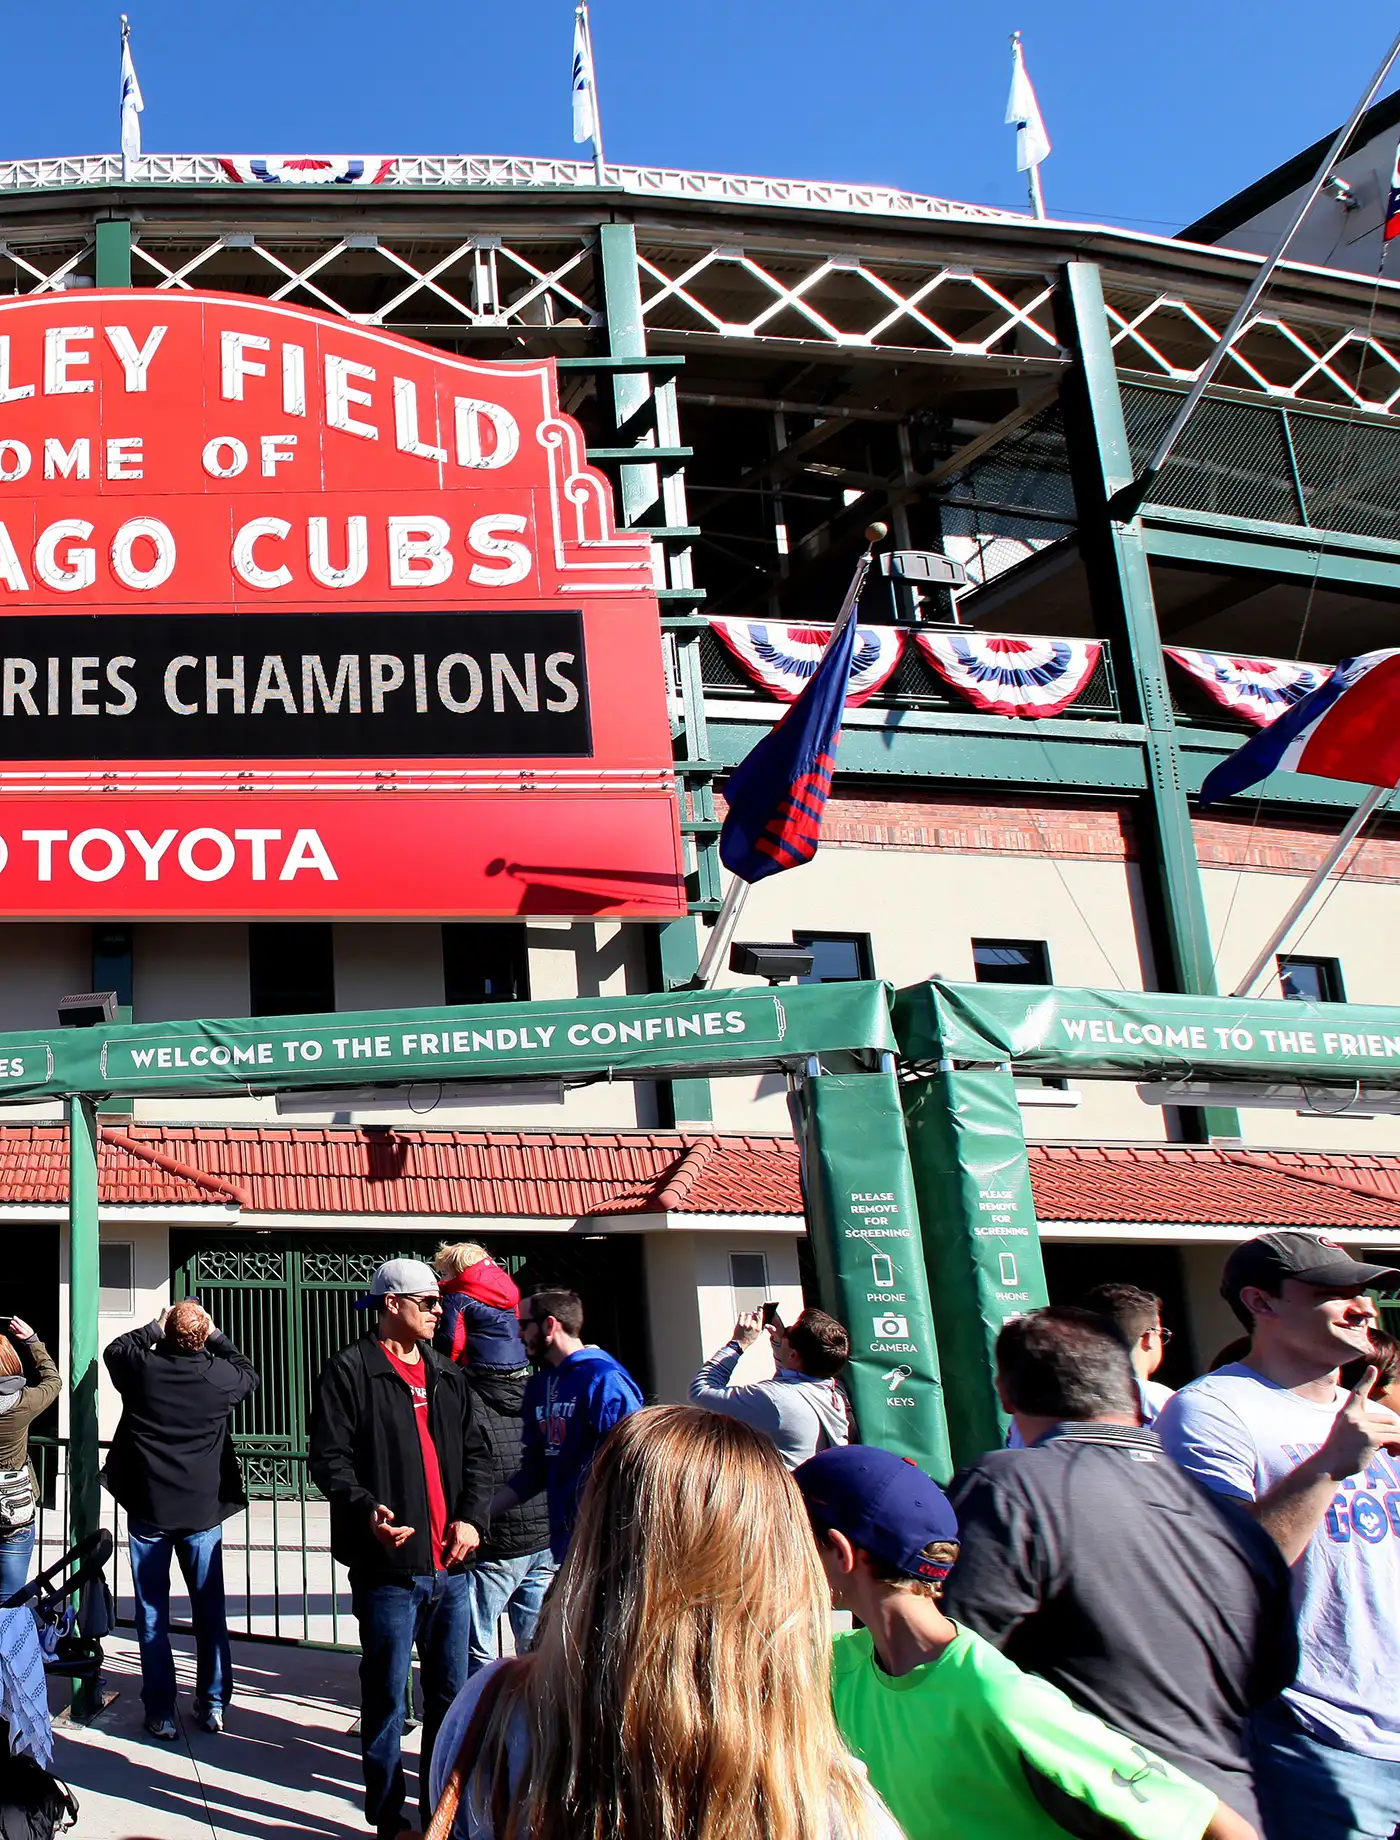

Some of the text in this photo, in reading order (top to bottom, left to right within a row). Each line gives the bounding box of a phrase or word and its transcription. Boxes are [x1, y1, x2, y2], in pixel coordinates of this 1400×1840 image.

[220, 330, 520, 470] FIELD
[201, 434, 298, 480] OF
[232, 513, 533, 590] CUBS
[163, 651, 580, 717] CHAMPIONS
[21, 826, 339, 882] TOYOTA
[130, 1010, 747, 1069] WELCOME TO THE FRIENDLY CONFINES
[1061, 1018, 1209, 1050] WELCOME
[1213, 1026, 1255, 1052] TO
[1259, 1029, 1318, 1054] THE
[851, 1192, 895, 1202] PLEASE
[979, 1190, 1014, 1199] PLEASE
[850, 1204, 899, 1214] REMOVE
[978, 1202, 1018, 1212] REMOVE
[864, 1216, 889, 1226] FOR
[991, 1214, 1012, 1223] FOR
[845, 1228, 912, 1239] SCREENING
[973, 1227, 1029, 1236] SCREENING
[866, 1293, 907, 1302] PHONE
[995, 1291, 1030, 1301] PHONE
[870, 1343, 918, 1353] CAMERA
[886, 1397, 915, 1407] KEYS
